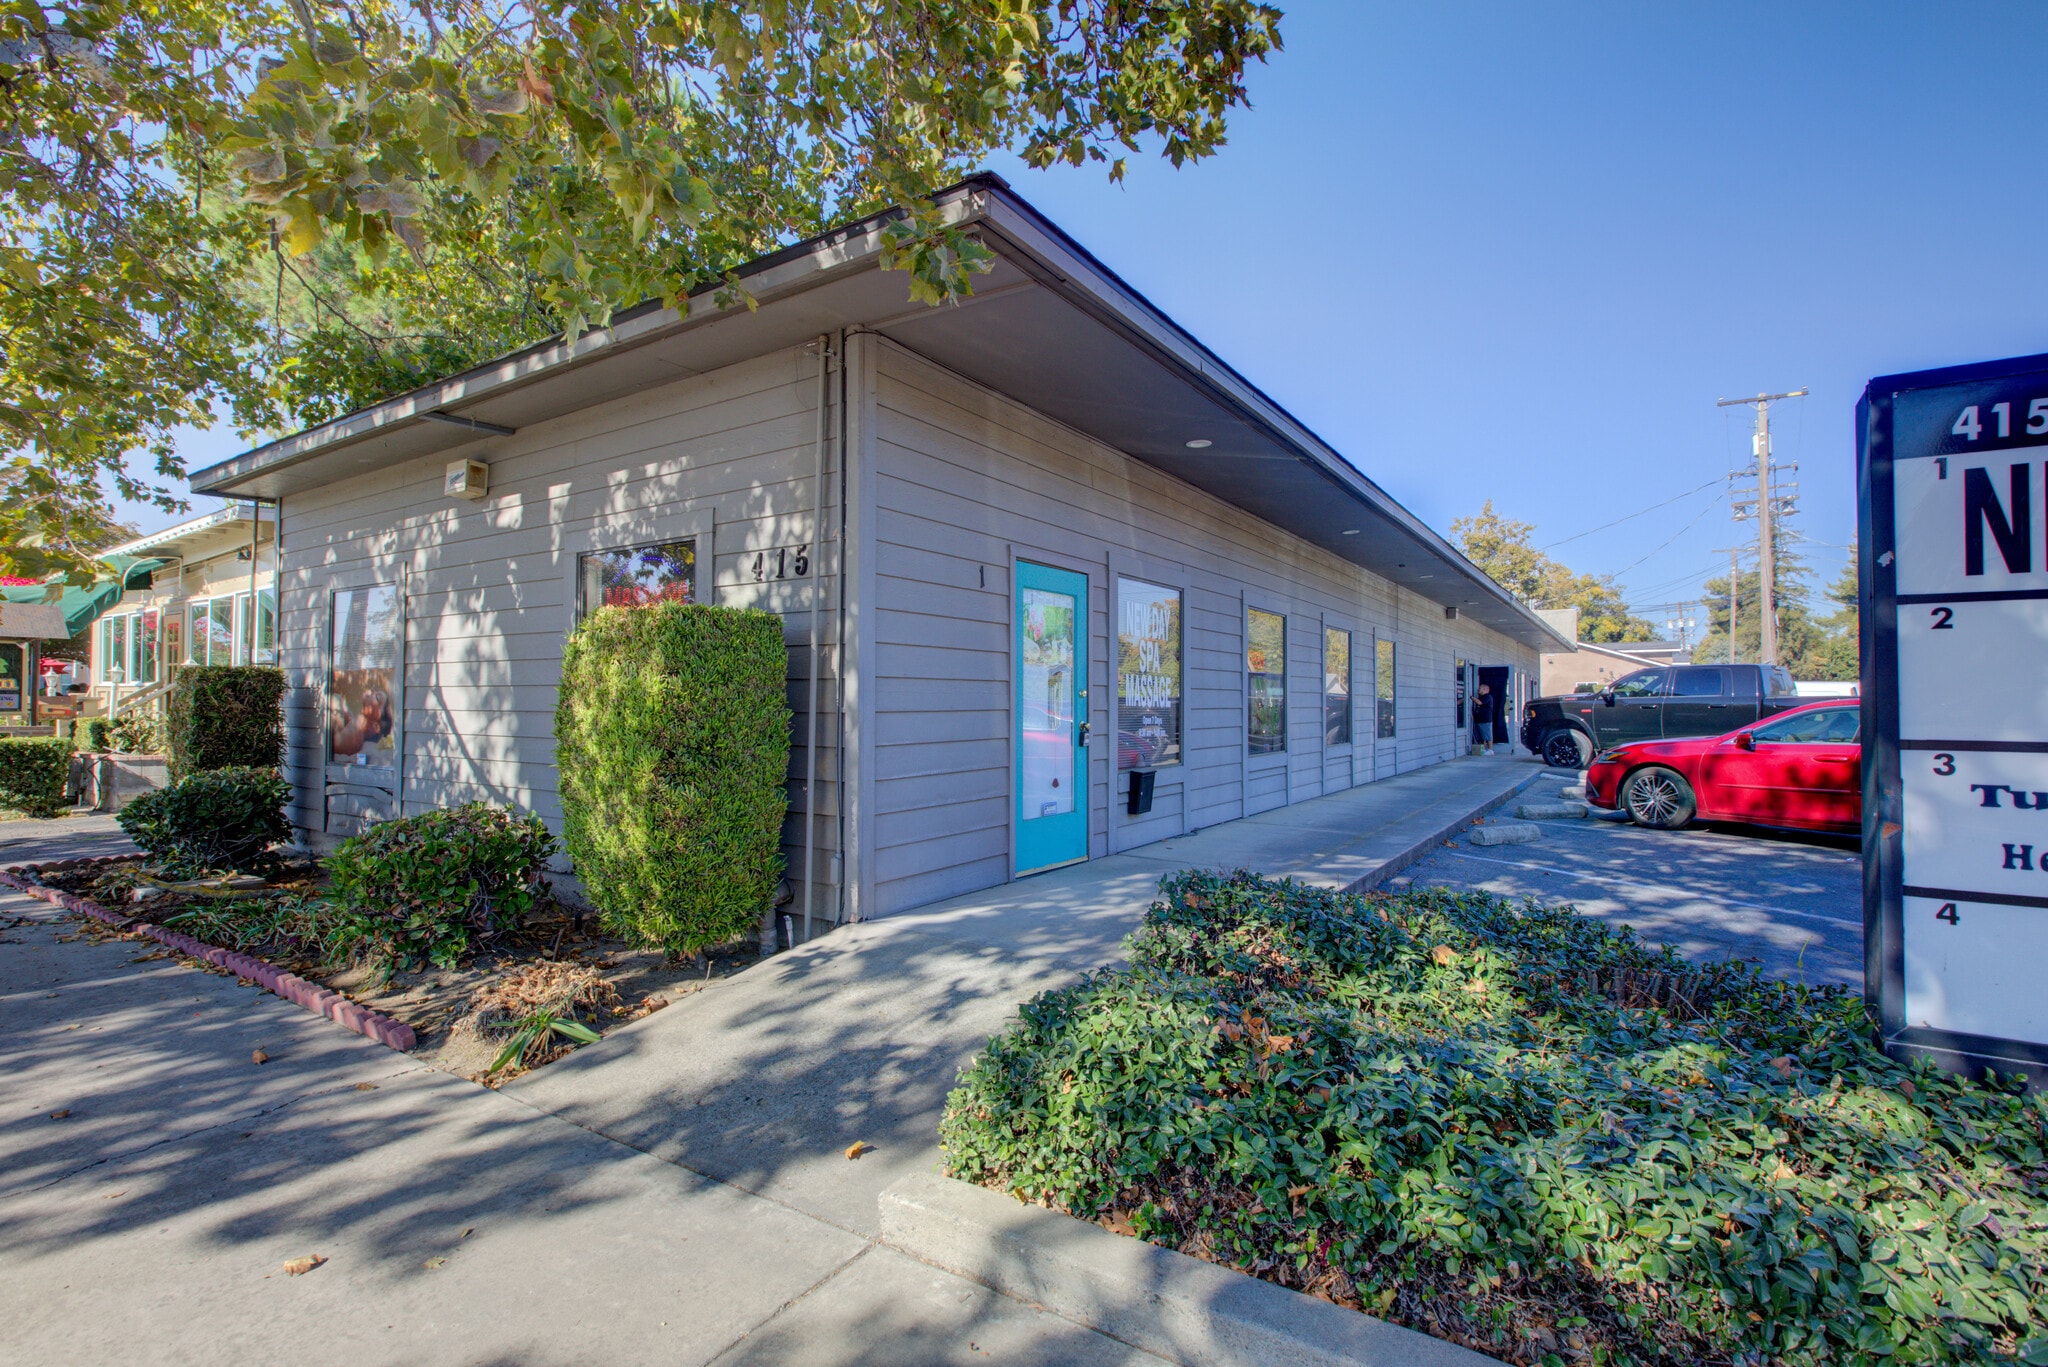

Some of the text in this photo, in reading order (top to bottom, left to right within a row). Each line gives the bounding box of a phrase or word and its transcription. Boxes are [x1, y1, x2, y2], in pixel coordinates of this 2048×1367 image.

[1952, 397, 2048, 441] 415
[1933, 457, 1948, 480] 1
[1964, 461, 2048, 576] N
[751, 544, 809, 582] 415
[979, 565, 986, 589] 1
[1126, 600, 1171, 641] NEW DAY
[1930, 606, 1954, 630] 2
[1139, 640, 1160, 673] SPA
[1125, 673, 1172, 708] MASSAGE
[1933, 753, 1956, 776] 3
[1935, 903, 1960, 926] 4
